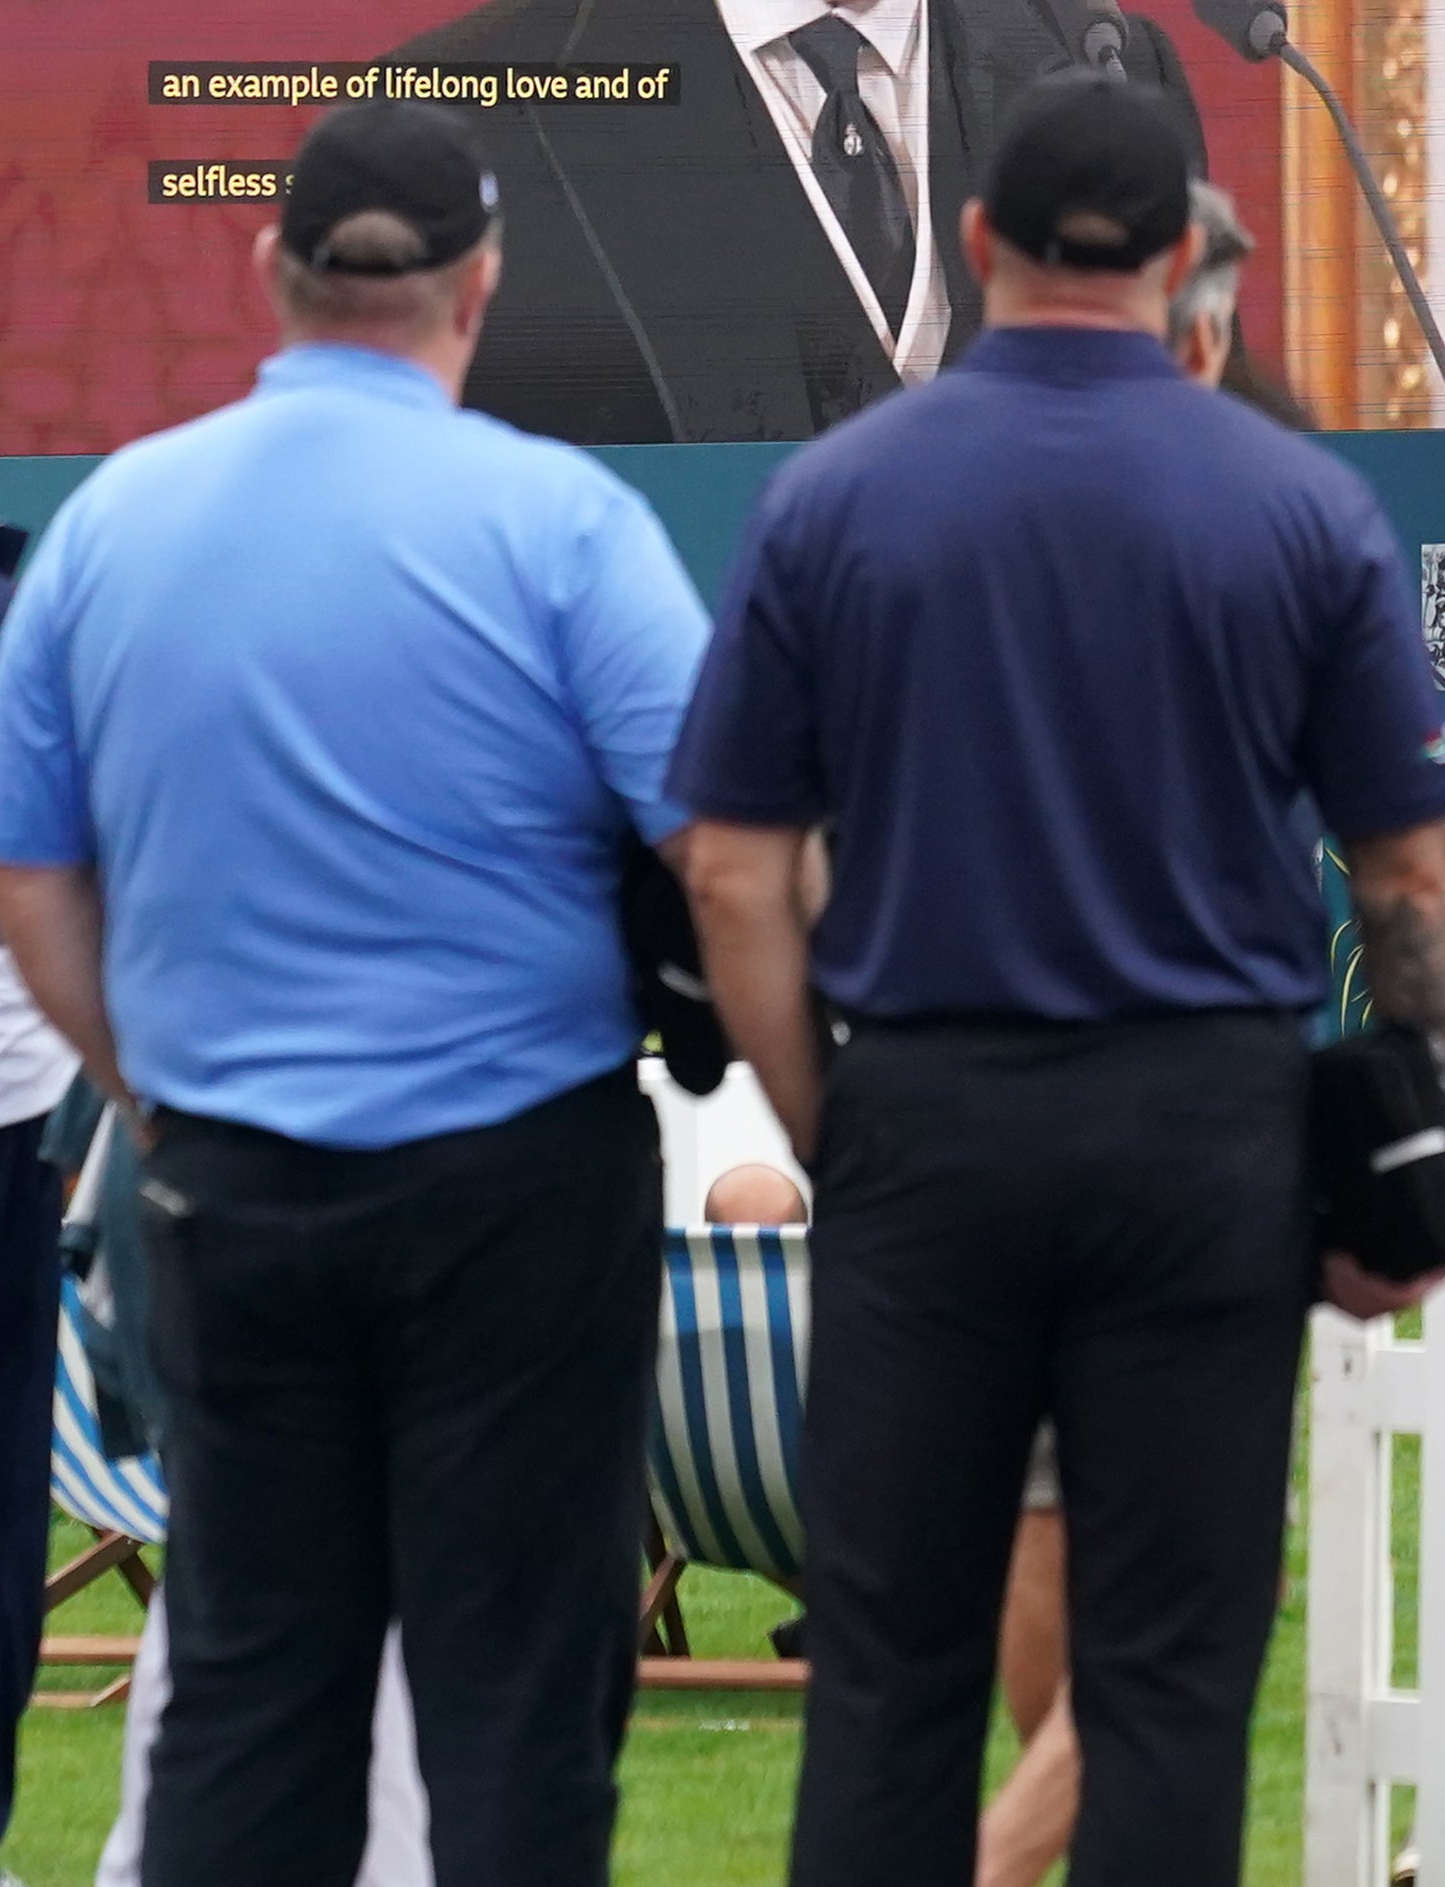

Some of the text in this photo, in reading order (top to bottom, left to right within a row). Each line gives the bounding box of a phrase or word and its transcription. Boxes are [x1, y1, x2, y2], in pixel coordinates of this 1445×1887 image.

[162, 66, 671, 107] an example of lifelong love and of
[162, 164, 277, 197] selfless
